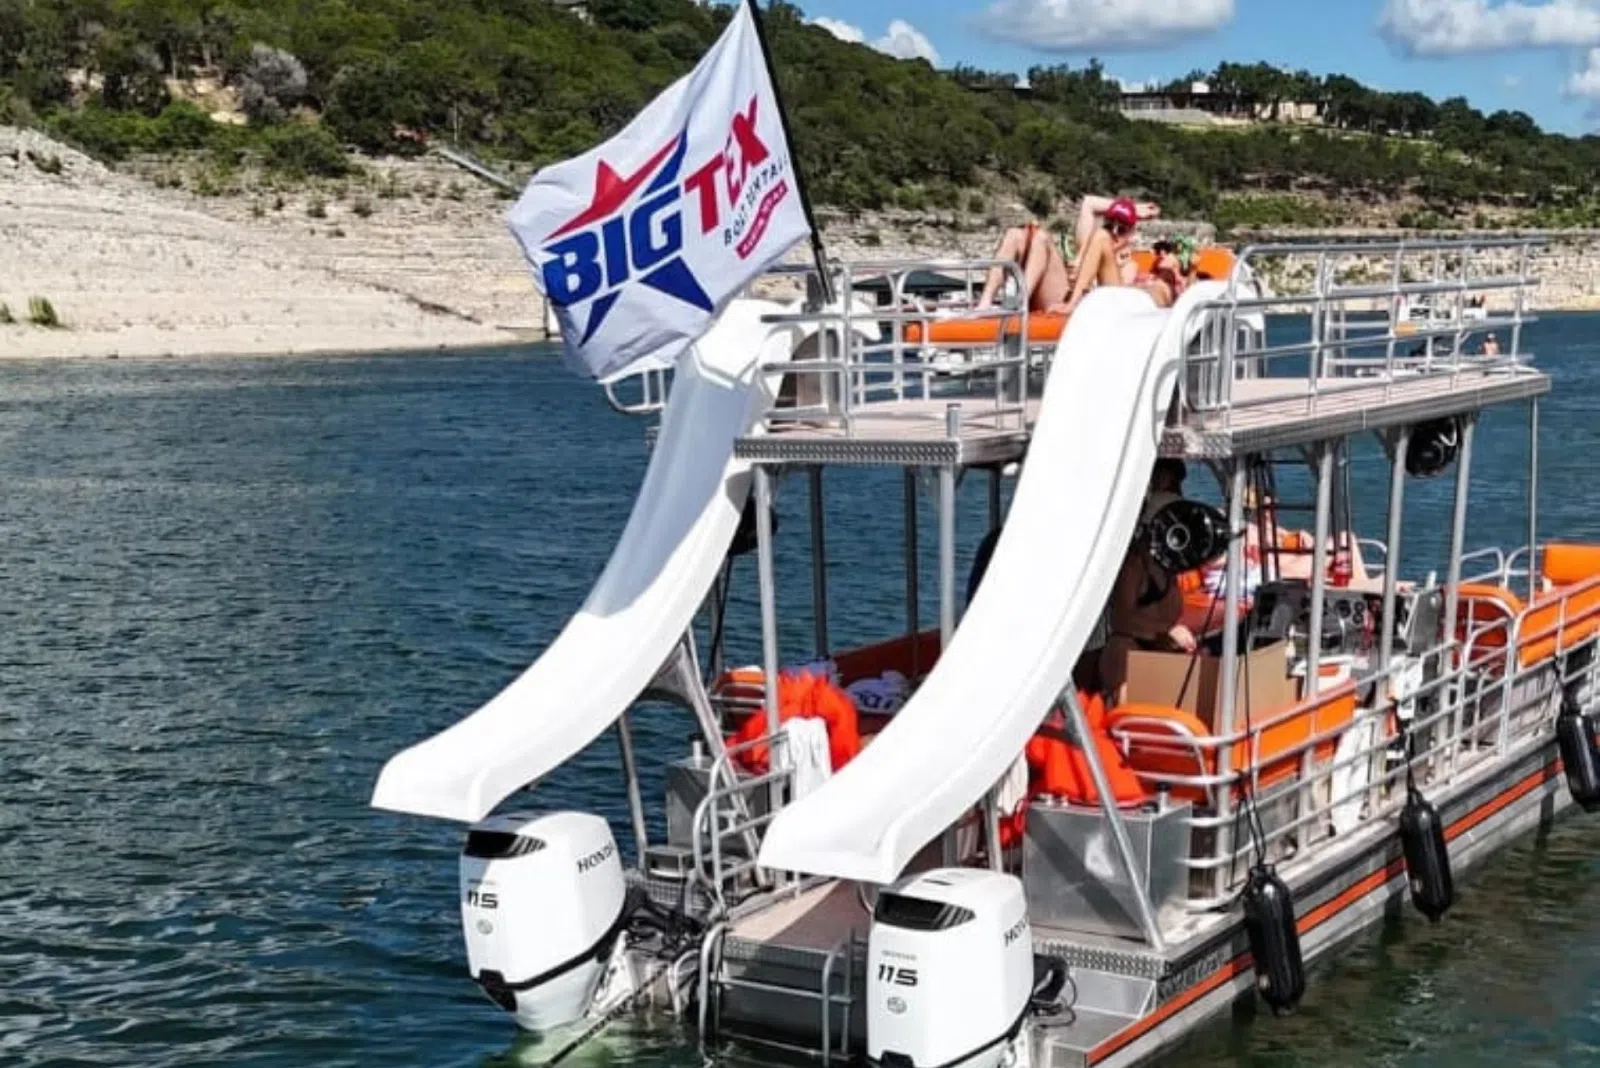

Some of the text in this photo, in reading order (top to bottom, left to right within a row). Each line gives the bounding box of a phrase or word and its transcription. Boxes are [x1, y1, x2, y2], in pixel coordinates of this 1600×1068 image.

[541, 185, 683, 307] BIG
[684, 94, 769, 234] TEX
[576, 841, 614, 873] HOND
[1003, 917, 1028, 947] HON
[878, 963, 918, 987] 115
